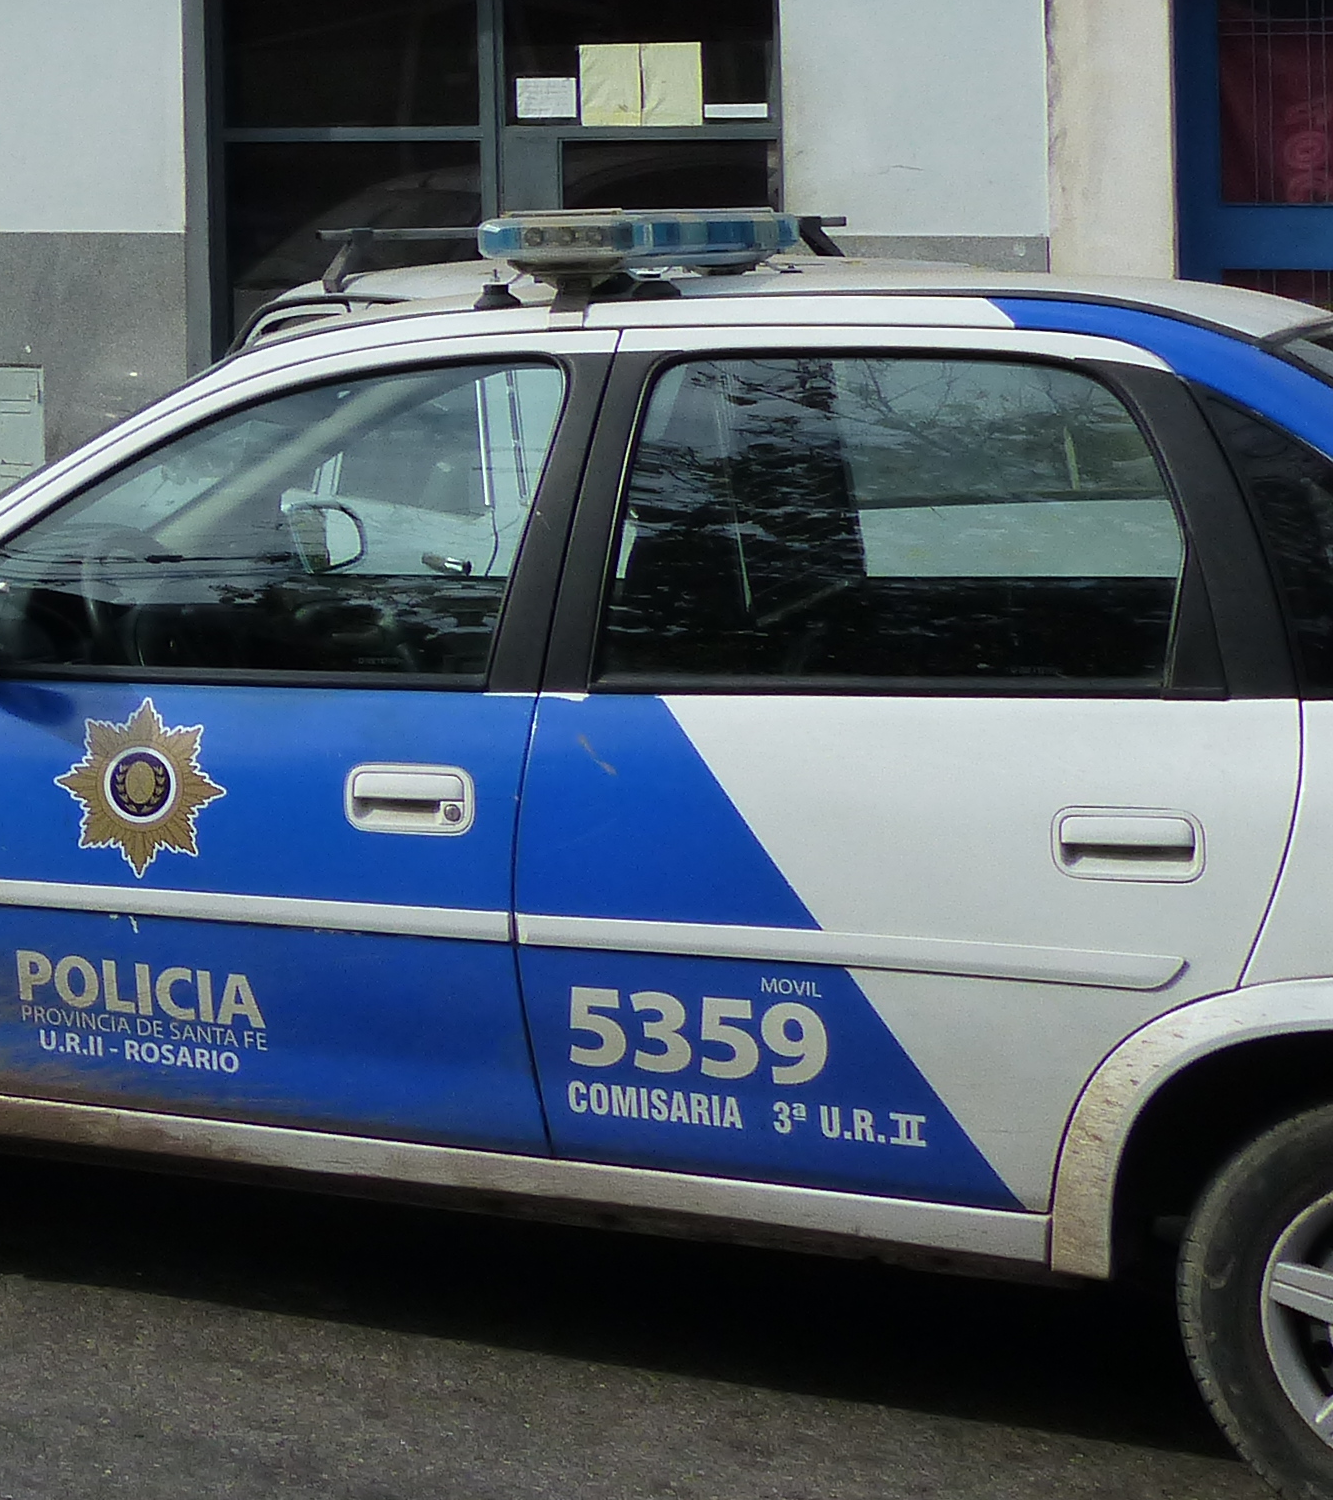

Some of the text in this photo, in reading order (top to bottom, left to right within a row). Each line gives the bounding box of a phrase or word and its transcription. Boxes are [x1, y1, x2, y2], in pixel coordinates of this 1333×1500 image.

[16, 949, 267, 1029] POLICIA
[760, 976, 823, 999] MOVIL
[20, 1004, 269, 1051] PROVINCIA DE SANTA FE
[569, 986, 829, 1085] 5359
[124, 1039, 241, 1074] ROSARIO
[567, 1079, 744, 1130] COMISARIA
